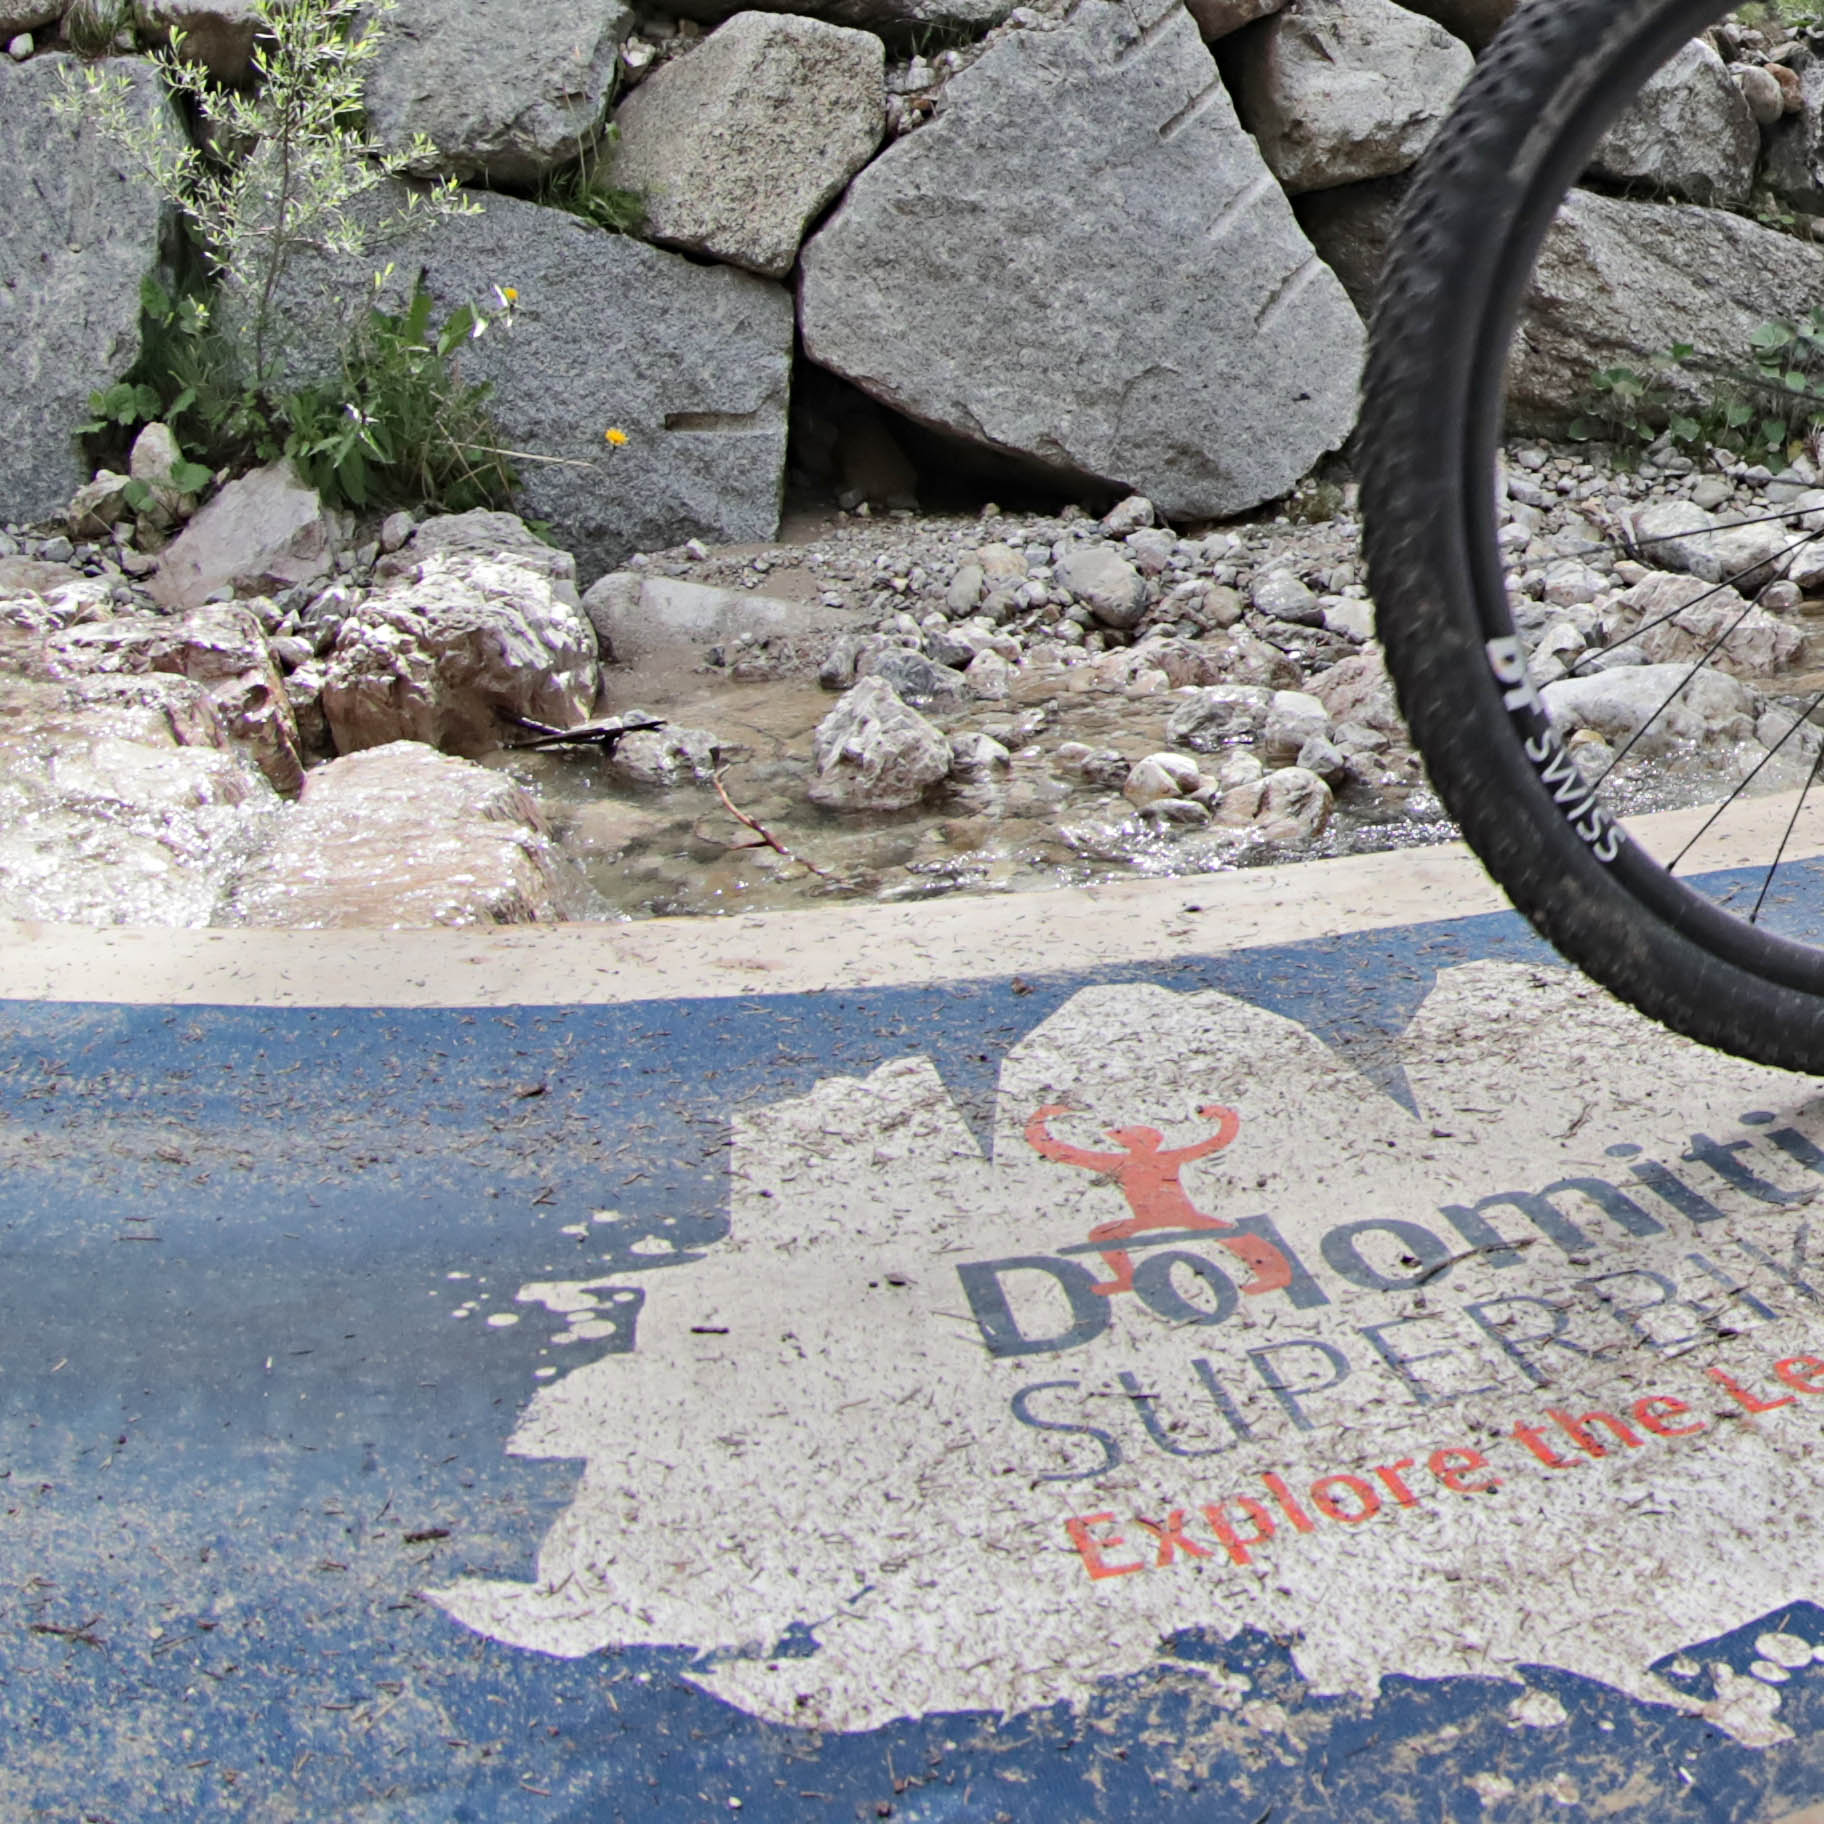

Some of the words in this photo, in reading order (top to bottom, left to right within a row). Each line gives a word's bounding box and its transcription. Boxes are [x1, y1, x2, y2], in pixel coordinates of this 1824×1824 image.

[1485, 635, 1545, 715] DT
[1525, 729, 1628, 863] SWISS
[1065, 1439, 1490, 1579] Explore
[1510, 1388, 1707, 1469] the
